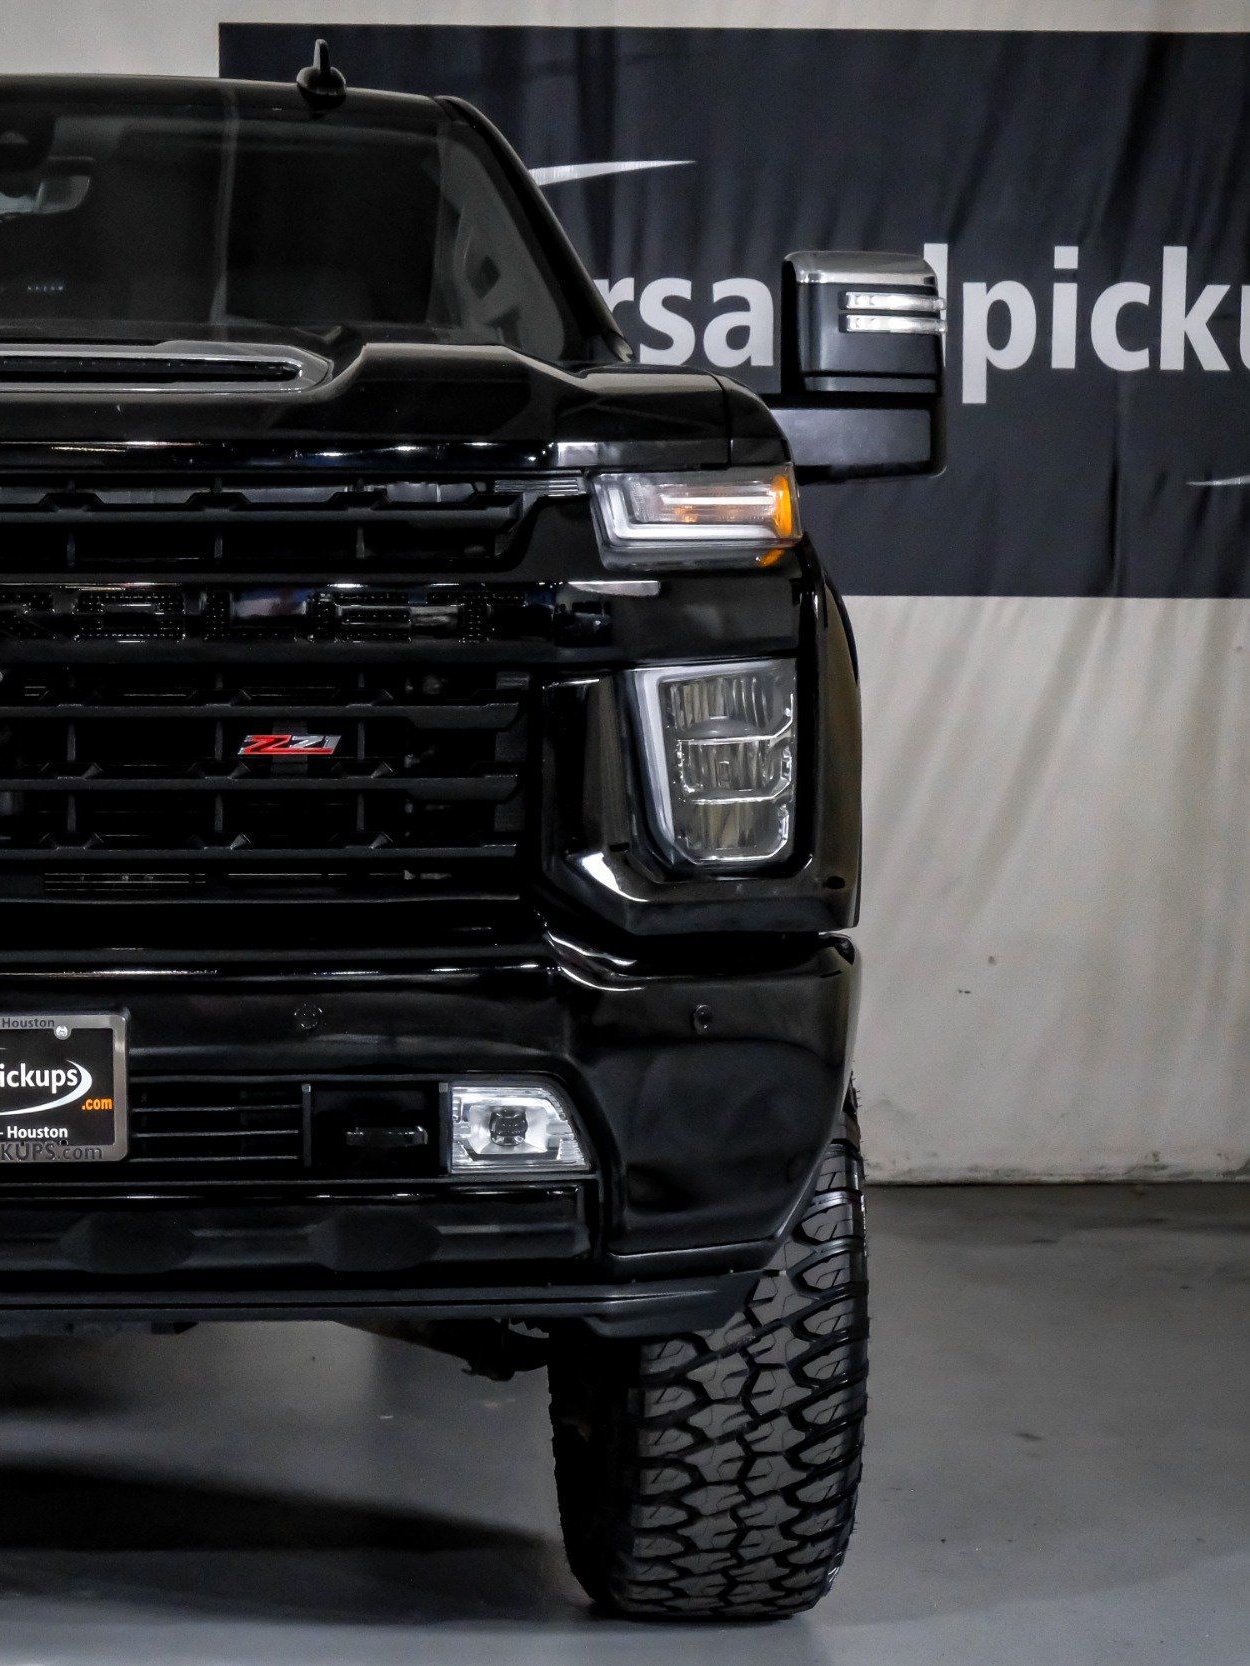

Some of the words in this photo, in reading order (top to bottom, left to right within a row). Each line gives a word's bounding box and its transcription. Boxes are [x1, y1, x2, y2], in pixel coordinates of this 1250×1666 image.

[2, 1017, 55, 1028] Houston
[81, 1097, 113, 1111] .com
[6, 1125, 69, 1139] Houston
